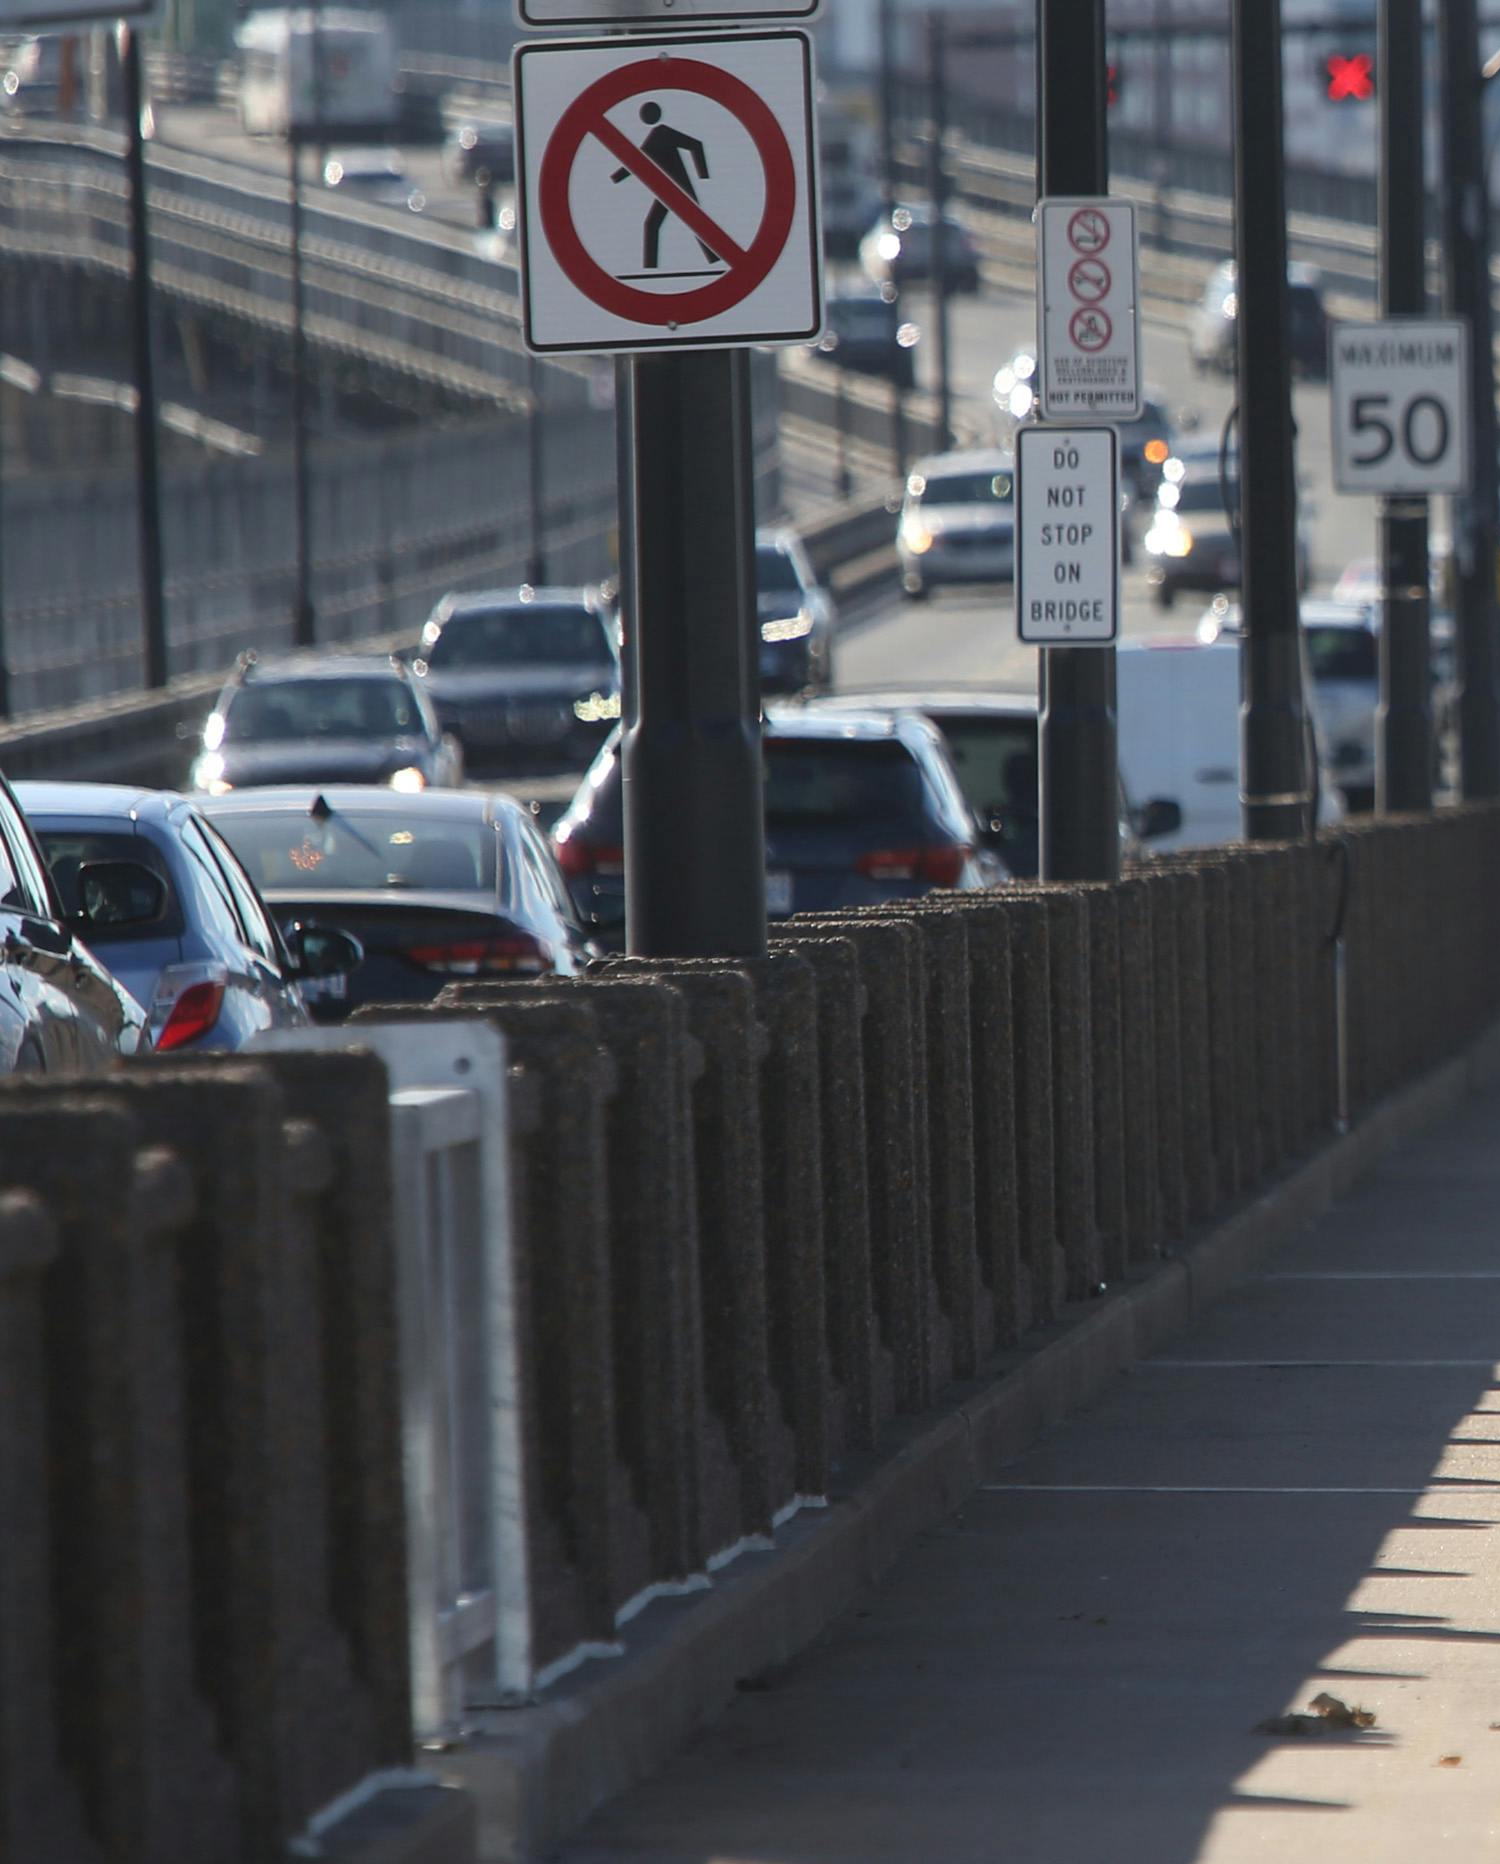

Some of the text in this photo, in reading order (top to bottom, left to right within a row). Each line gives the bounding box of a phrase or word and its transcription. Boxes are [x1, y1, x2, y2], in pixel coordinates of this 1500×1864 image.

[1340, 341, 1454, 367] MAXIMUM
[1048, 391, 1070, 404] NOT
[1350, 394, 1450, 468] 50
[1053, 450, 1079, 470] DO
[1047, 487, 1086, 508] NOT
[1041, 525, 1093, 546] STOP
[1054, 562, 1081, 584] ON
[1031, 600, 1103, 622] BRIDGE
